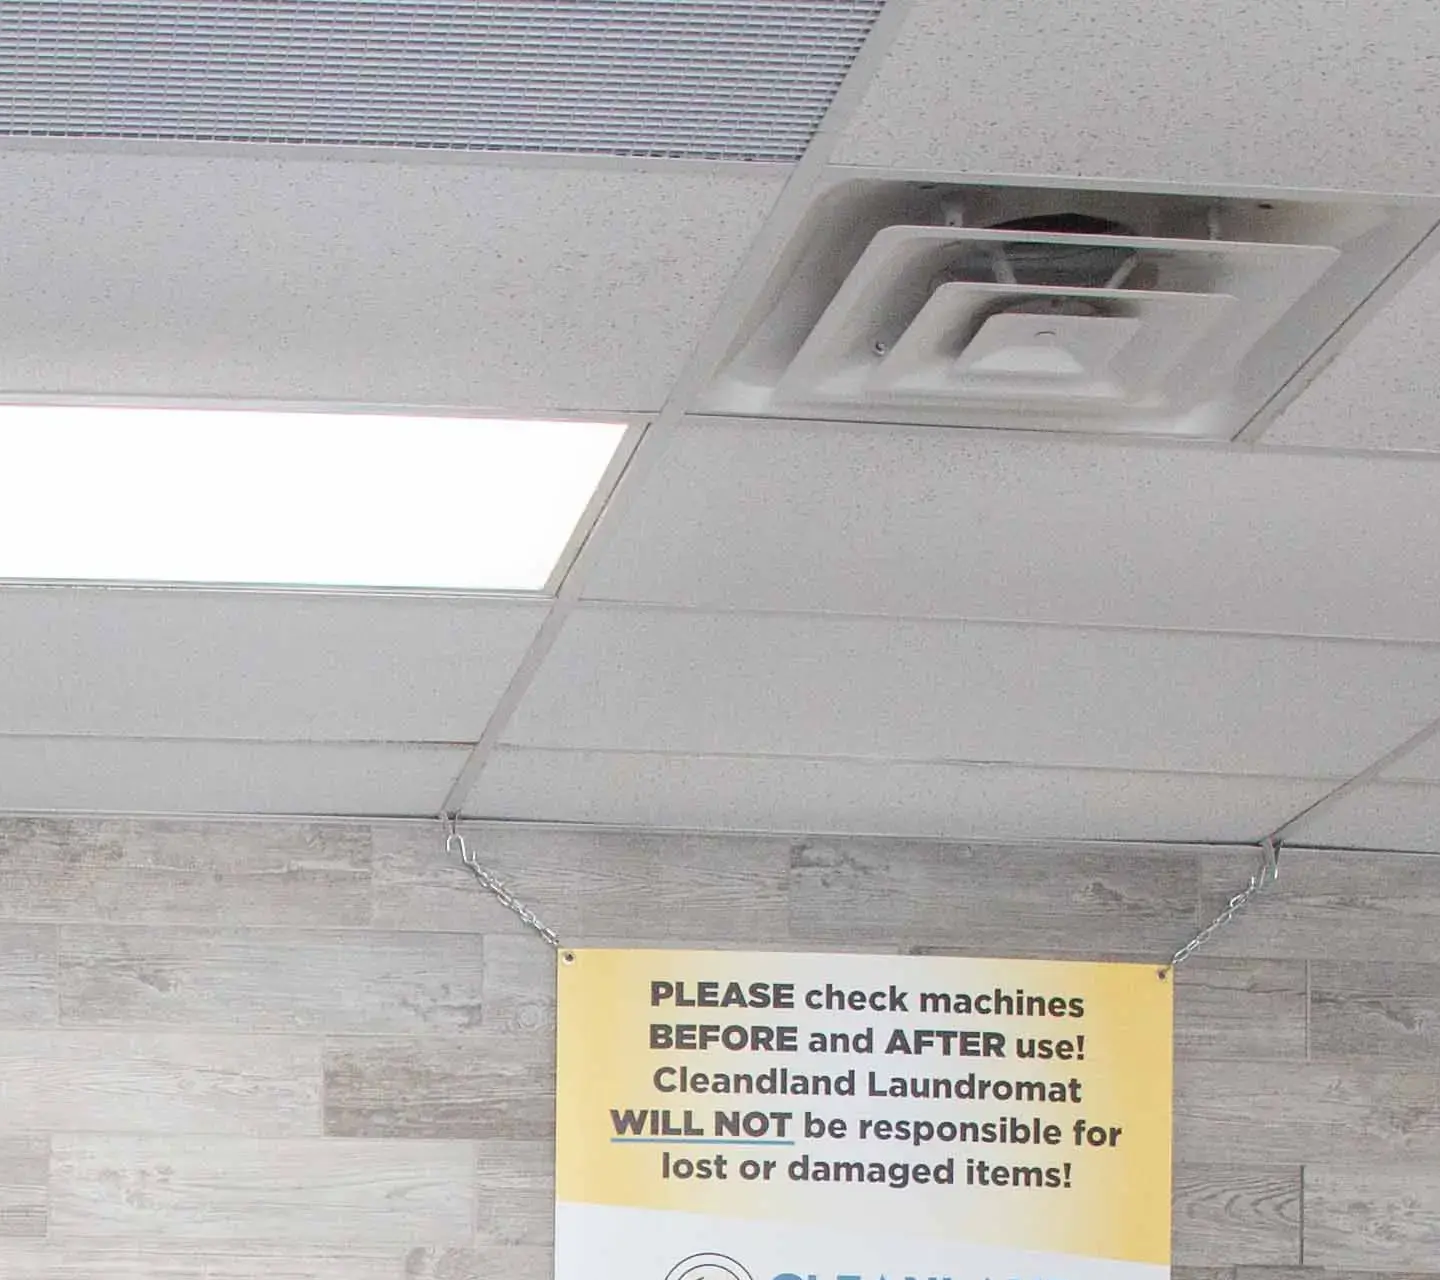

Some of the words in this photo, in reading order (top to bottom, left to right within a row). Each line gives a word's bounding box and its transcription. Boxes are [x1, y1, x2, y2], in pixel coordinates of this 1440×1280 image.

[650, 982, 794, 1009] PLEASE
[804, 984, 909, 1013] check
[920, 987, 1084, 1019] machines
[649, 1025, 798, 1052] BEFORE
[808, 1028, 873, 1054] and
[885, 1030, 1005, 1058] AFTER
[1015, 1034, 1084, 1061] use!
[653, 1067, 855, 1096] Cleandland
[868, 1072, 1082, 1103] Laundromat
[610, 1110, 703, 1137] WILL
[715, 1111, 792, 1138] NOT
[803, 1112, 847, 1140] be
[858, 1115, 1061, 1151] responsible
[1072, 1120, 1123, 1147] for
[661, 1153, 727, 1180] lost
[740, 1157, 776, 1182] or
[787, 1156, 954, 1190] damaged
[966, 1161, 1072, 1188] items!
